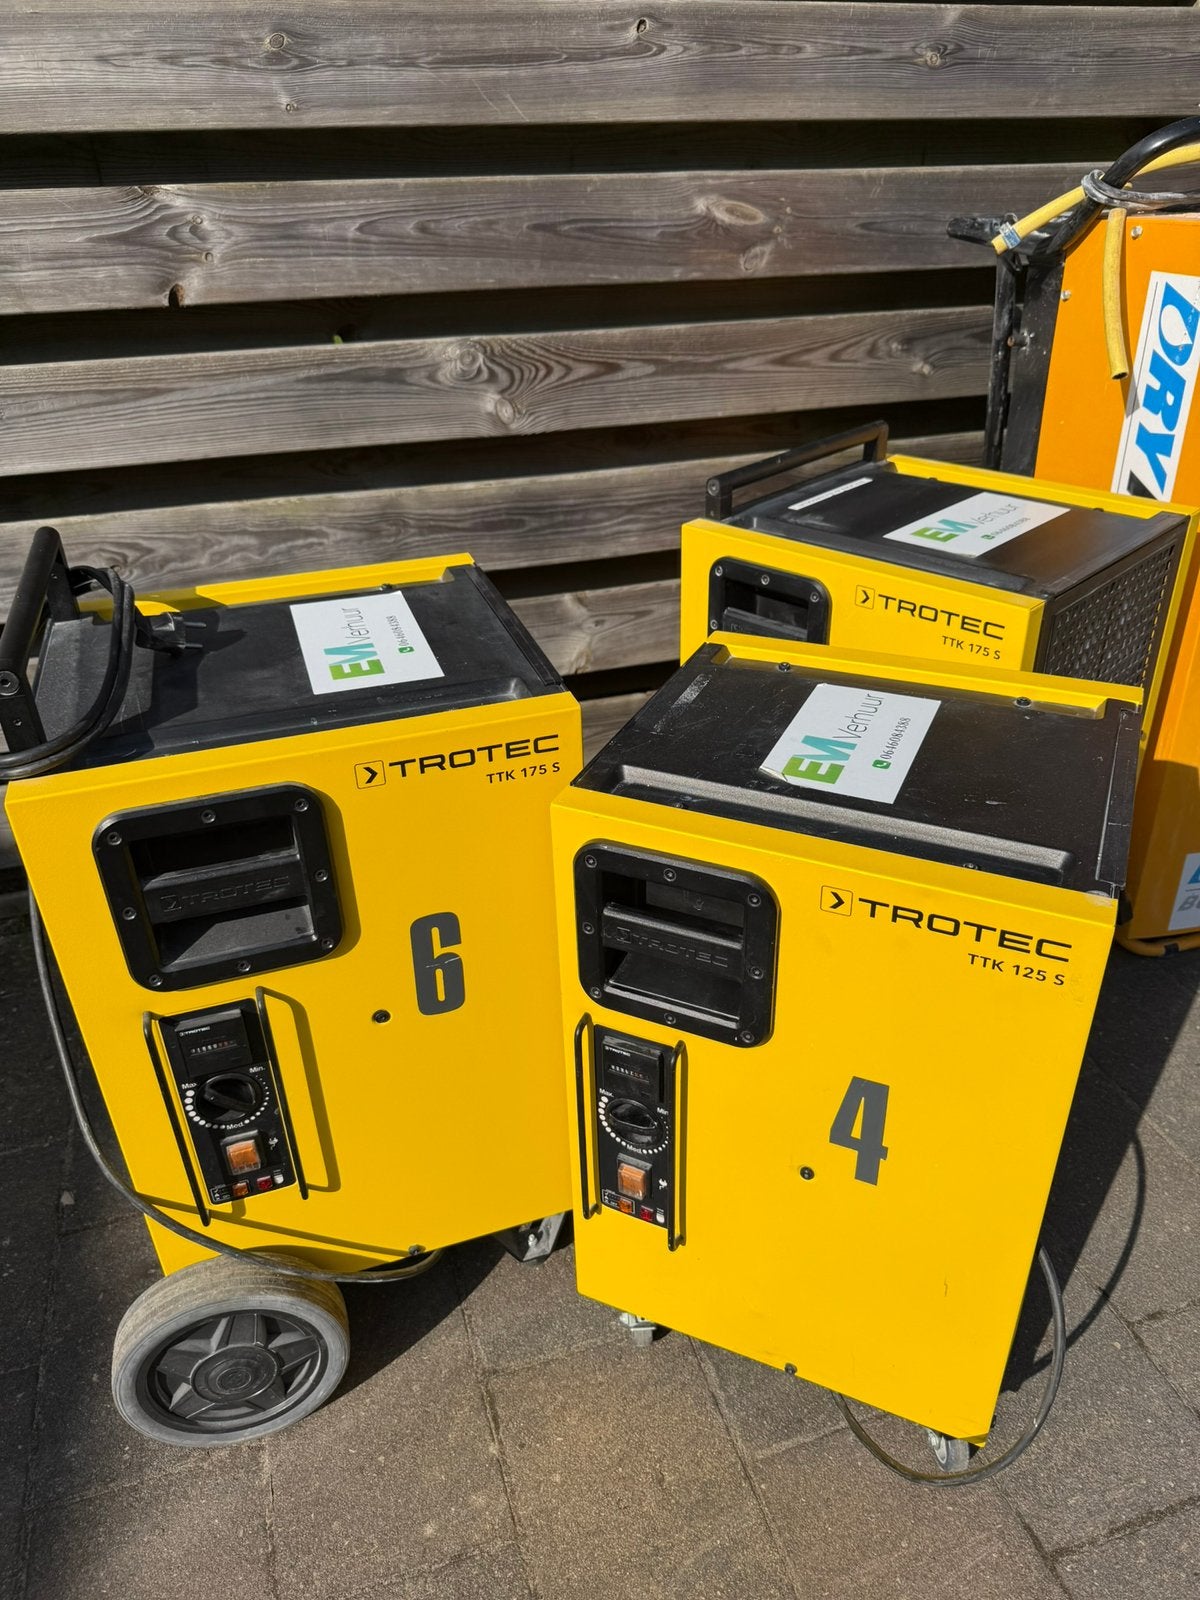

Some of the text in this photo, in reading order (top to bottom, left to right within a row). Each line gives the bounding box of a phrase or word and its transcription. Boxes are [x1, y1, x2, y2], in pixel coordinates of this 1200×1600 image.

[910, 519, 978, 543] EM
[878, 594, 1005, 640] TROTEC
[323, 607, 385, 680] EM Verhuur
[942, 635, 1001, 660] TTK 175 S
[389, 734, 559, 777] TROTEC
[782, 693, 885, 784] EM Verhuur
[880, 717, 912, 760] 0646084388
[486, 762, 561, 784] TTK 175 S
[858, 897, 1073, 963] TROTEC
[409, 912, 466, 1016] 6
[968, 953, 1065, 986] TTK 125 S
[829, 1076, 890, 1186] 4
